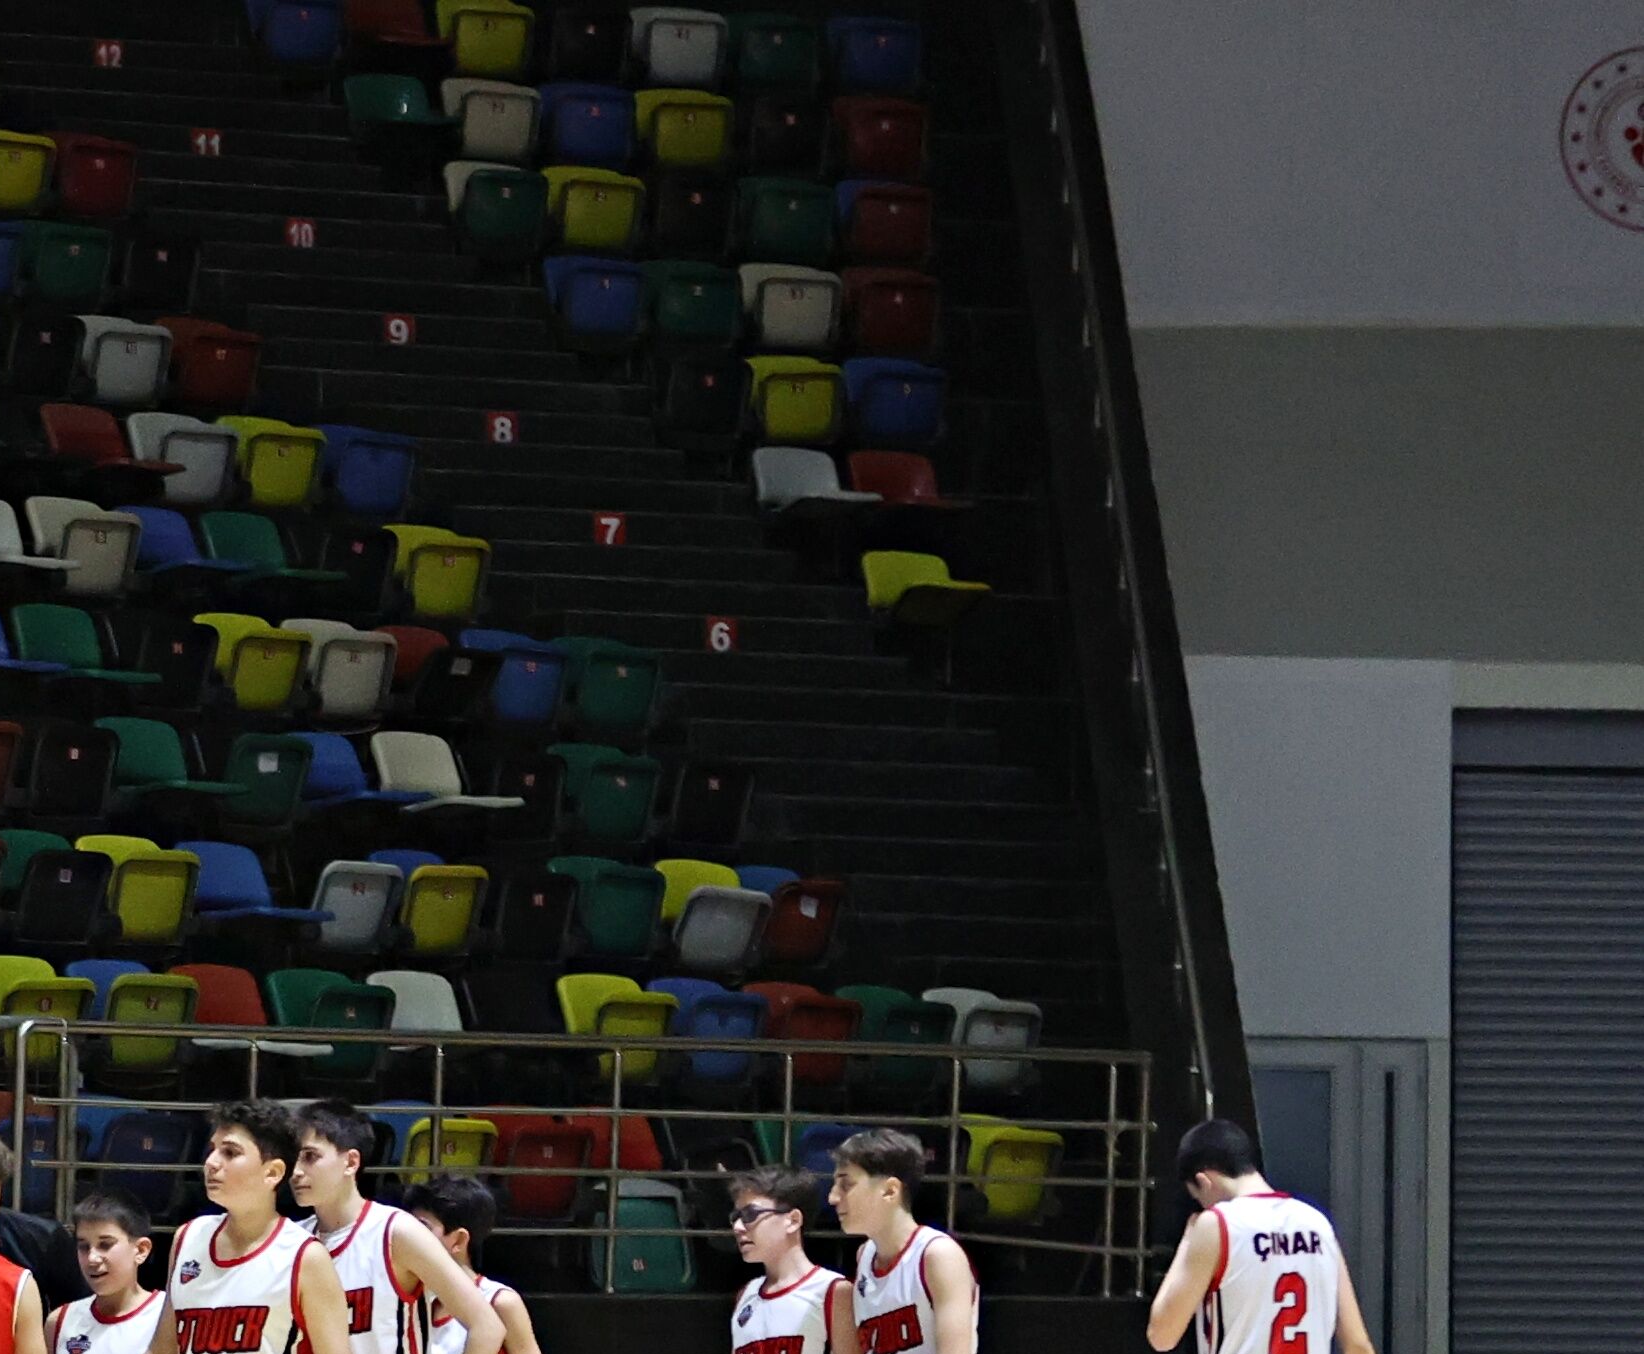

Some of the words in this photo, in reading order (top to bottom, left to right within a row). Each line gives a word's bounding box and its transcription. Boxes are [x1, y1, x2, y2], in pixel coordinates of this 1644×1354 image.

[98, 44, 122, 67] 12
[196, 133, 220, 156] 11
[289, 223, 313, 247] 10
[389, 318, 409, 344] 9
[493, 416, 512, 443] 8
[600, 517, 621, 545] 7
[710, 621, 731, 652] 6
